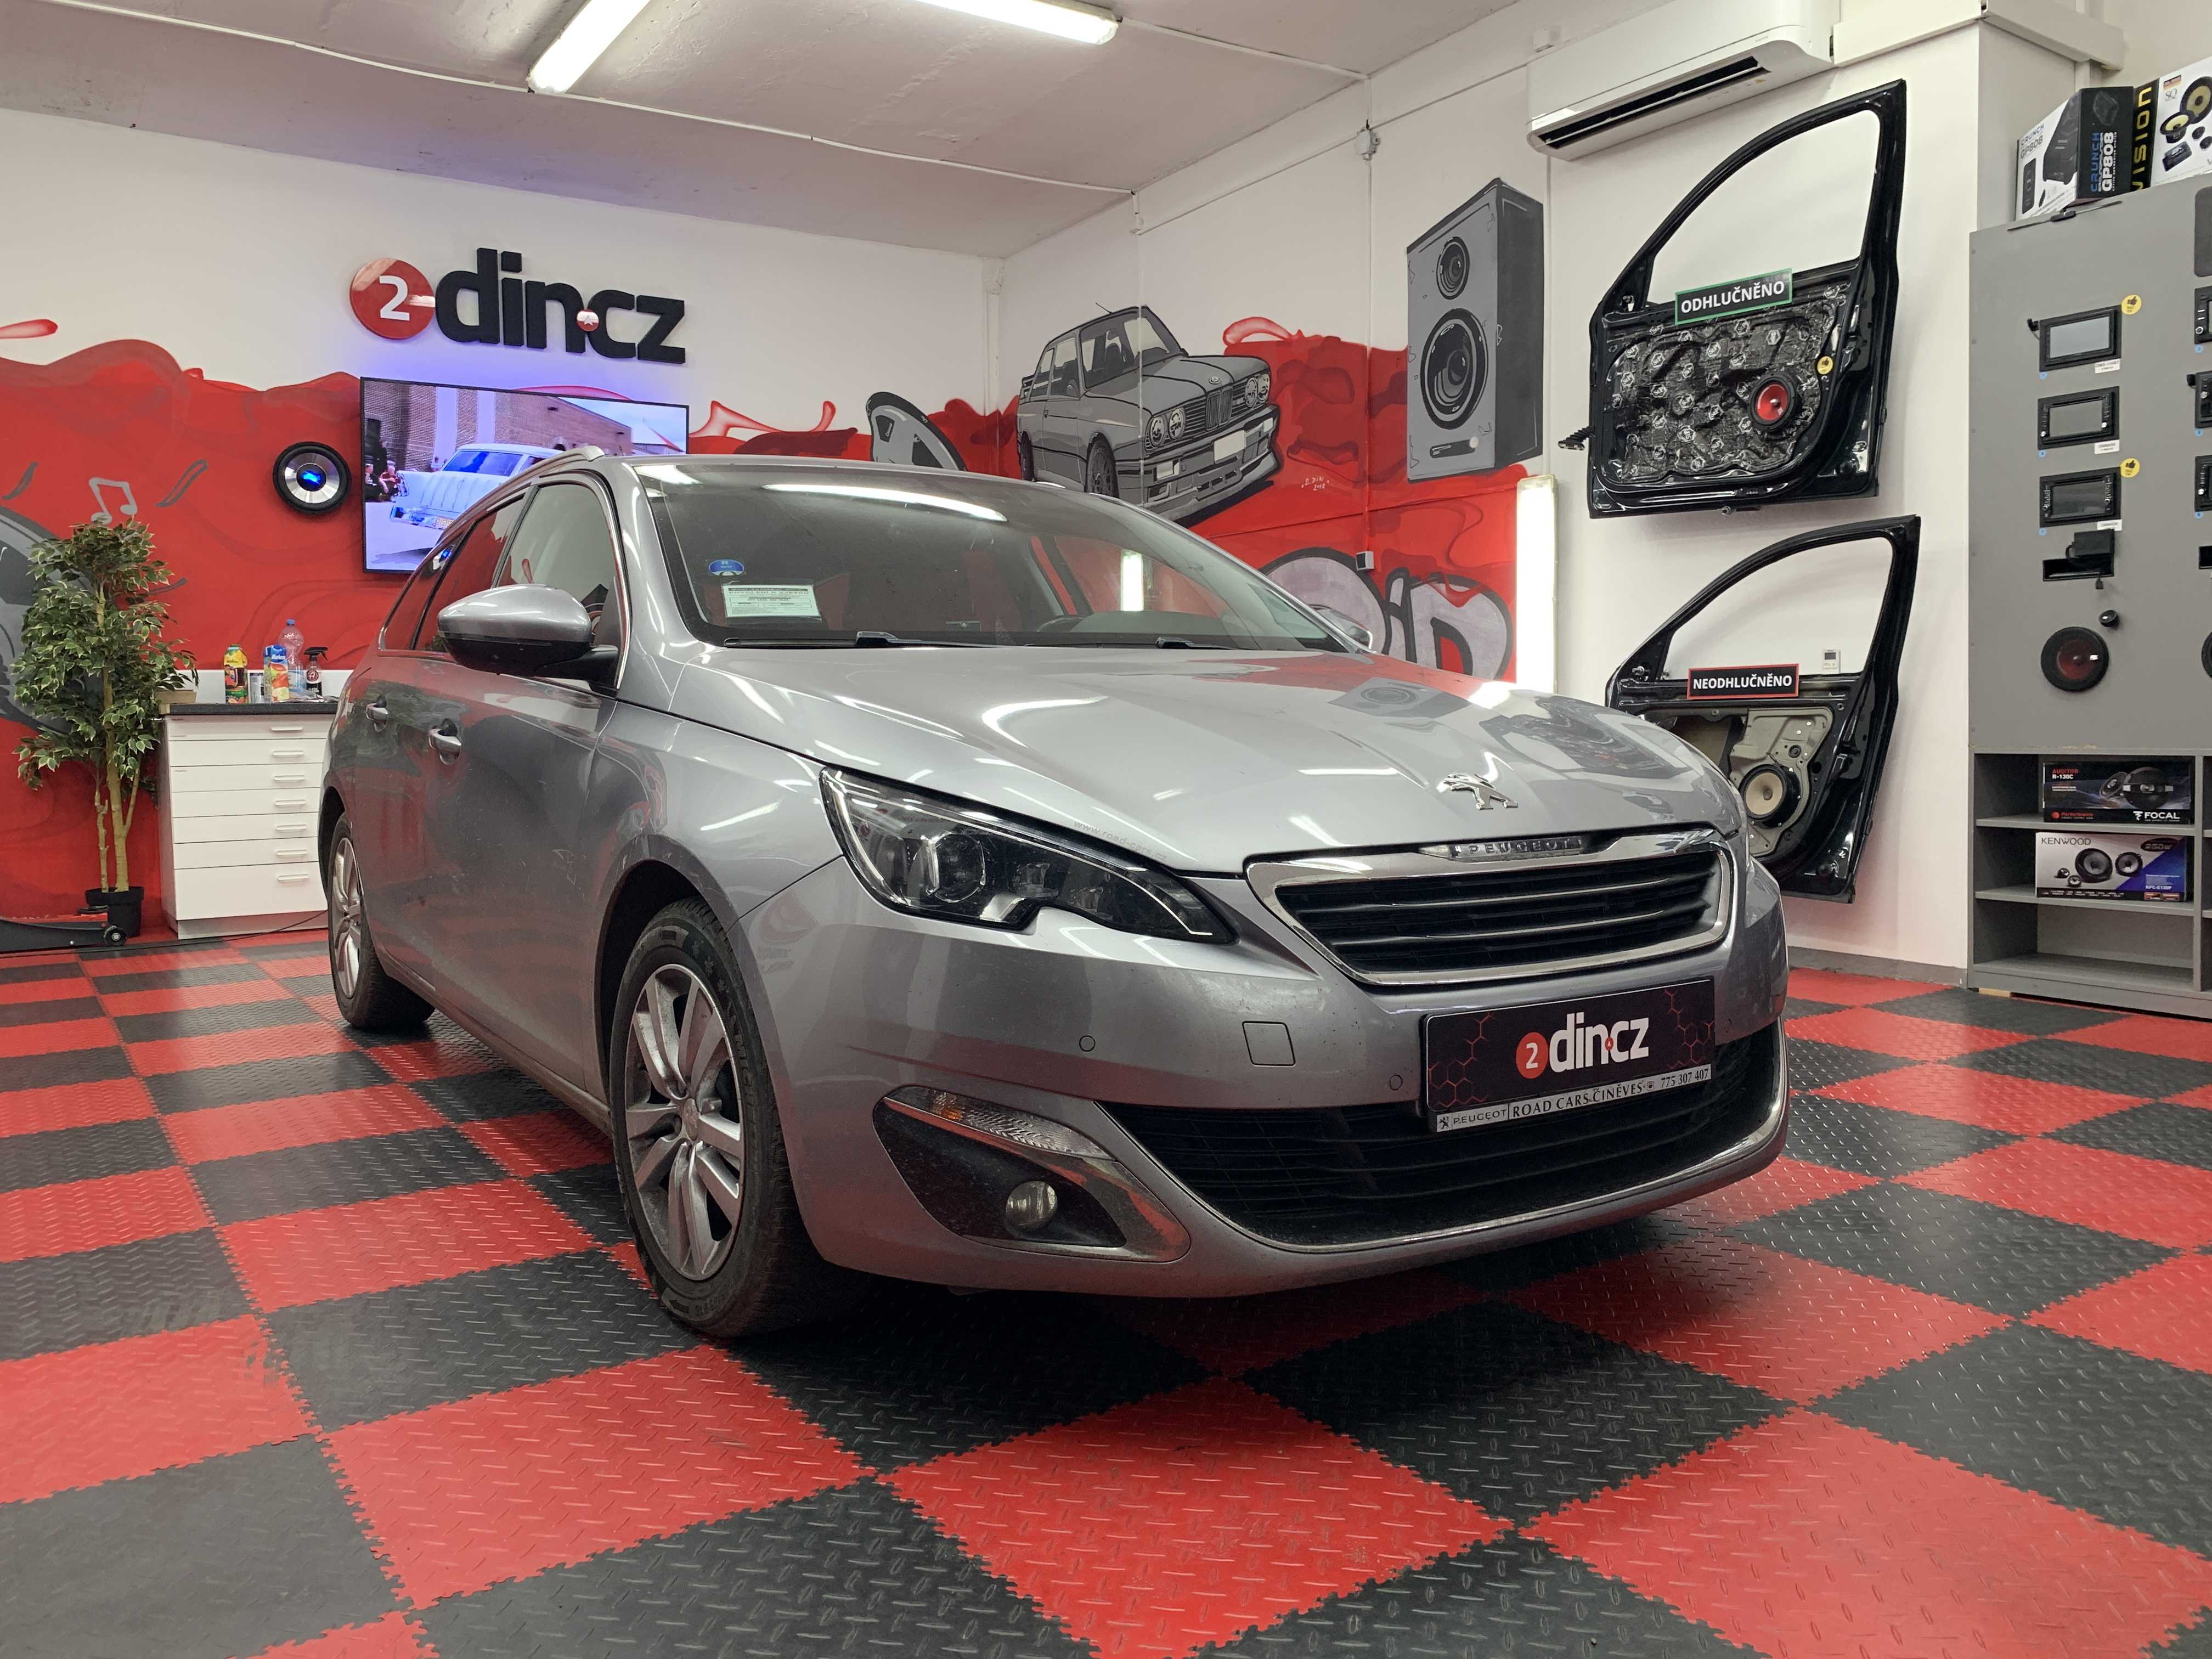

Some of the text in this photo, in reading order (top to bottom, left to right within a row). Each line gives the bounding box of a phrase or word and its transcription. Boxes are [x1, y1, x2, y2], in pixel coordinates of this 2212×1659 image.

[2021, 135, 2043, 159] GP808
[2102, 132, 2114, 191] GP808
[2090, 132, 2100, 192] CRUNCH
[1680, 280, 1785, 314] ODHLUČNĚNO
[1692, 673, 1793, 690] NEODHLUČNĚNO
[1468, 839, 1571, 854] PEUGEOT
[2041, 837, 2091, 845] KENWOOD
[1453, 1068, 1709, 1125] PEUGEOT ROAD CARS ČINĚVES 775 307 407
